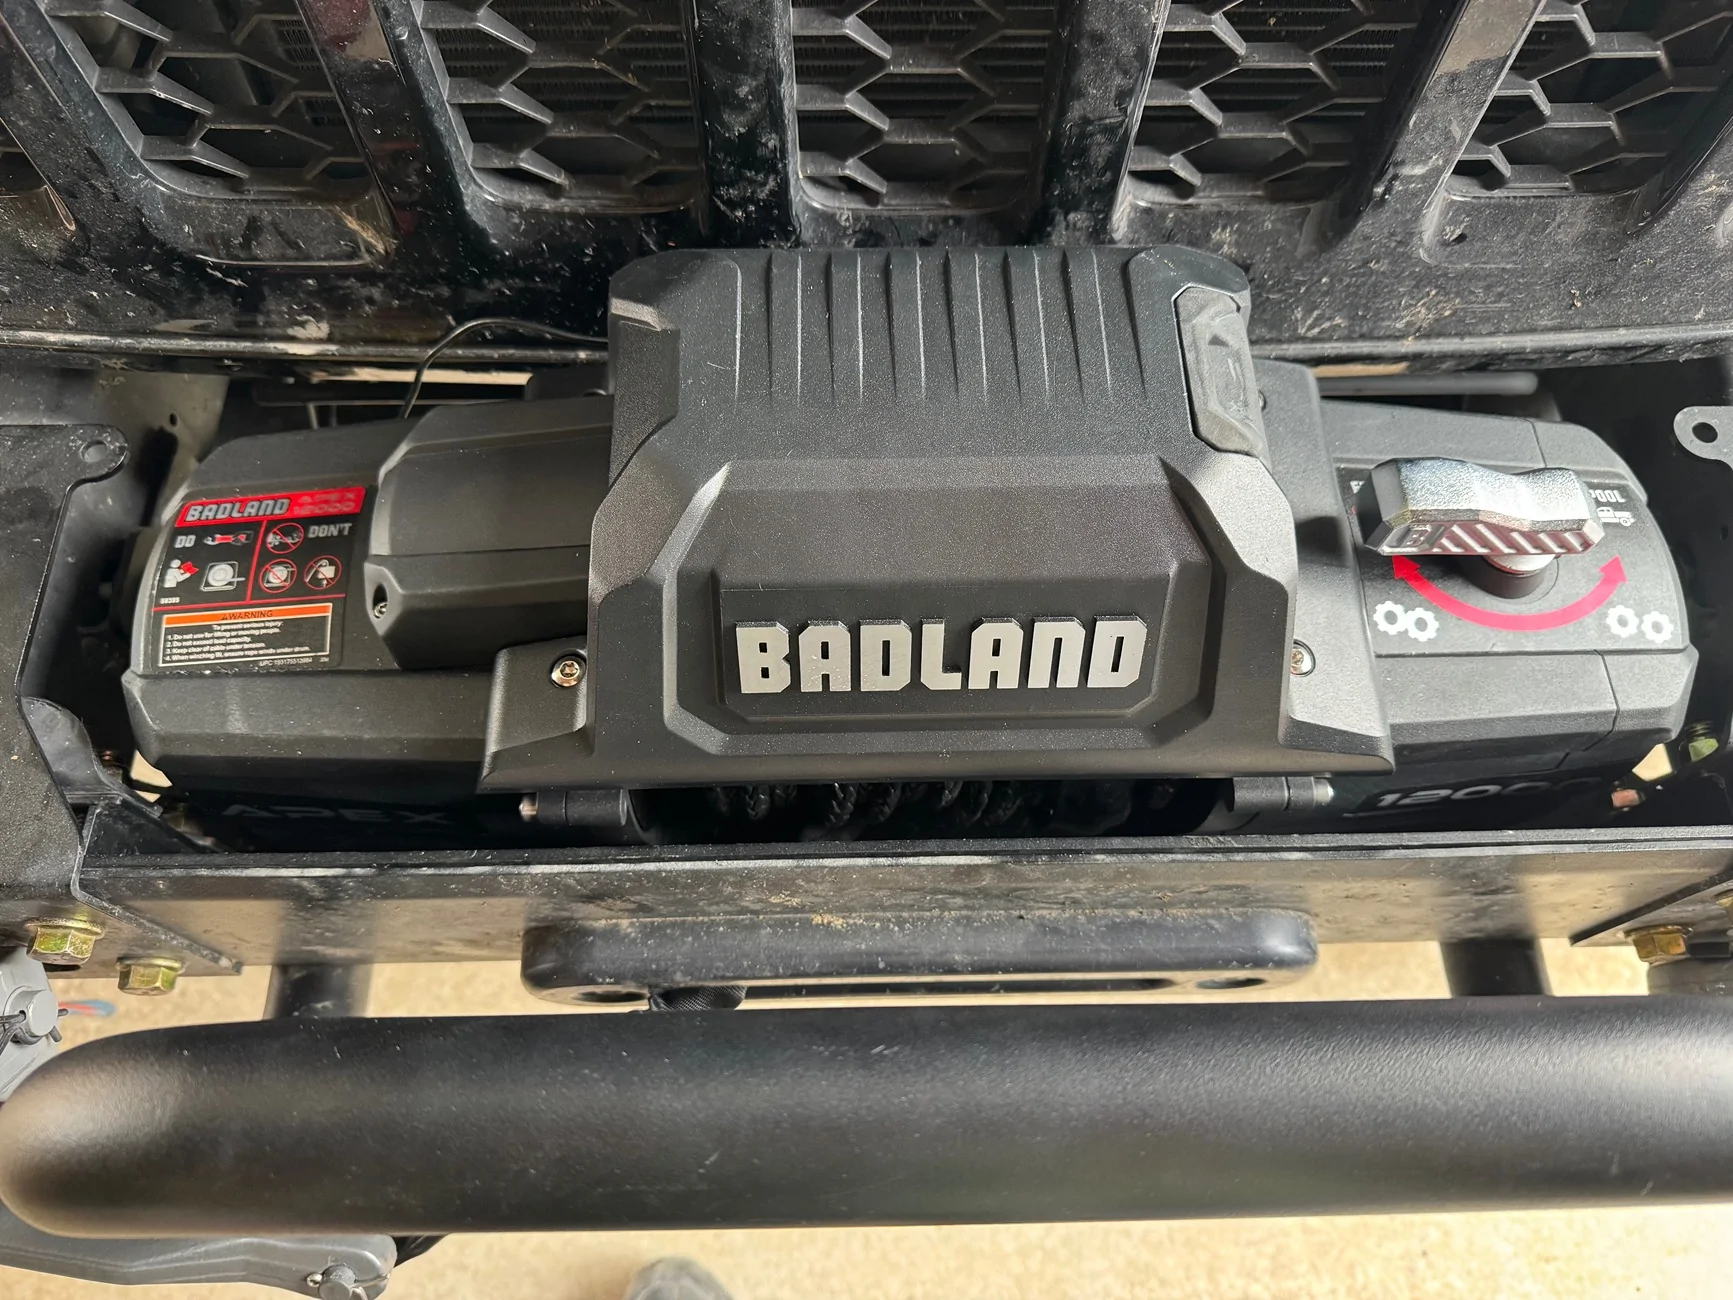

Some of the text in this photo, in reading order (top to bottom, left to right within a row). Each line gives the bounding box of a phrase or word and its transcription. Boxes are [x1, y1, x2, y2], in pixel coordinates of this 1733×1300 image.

[185, 498, 291, 522] BADLAND
[294, 501, 356, 515] 12000
[308, 523, 353, 539] DON'T
[175, 535, 197, 549] DO
[229, 610, 273, 620] WARNING
[736, 615, 1147, 694] BADLAND
[221, 804, 454, 825] APEX
